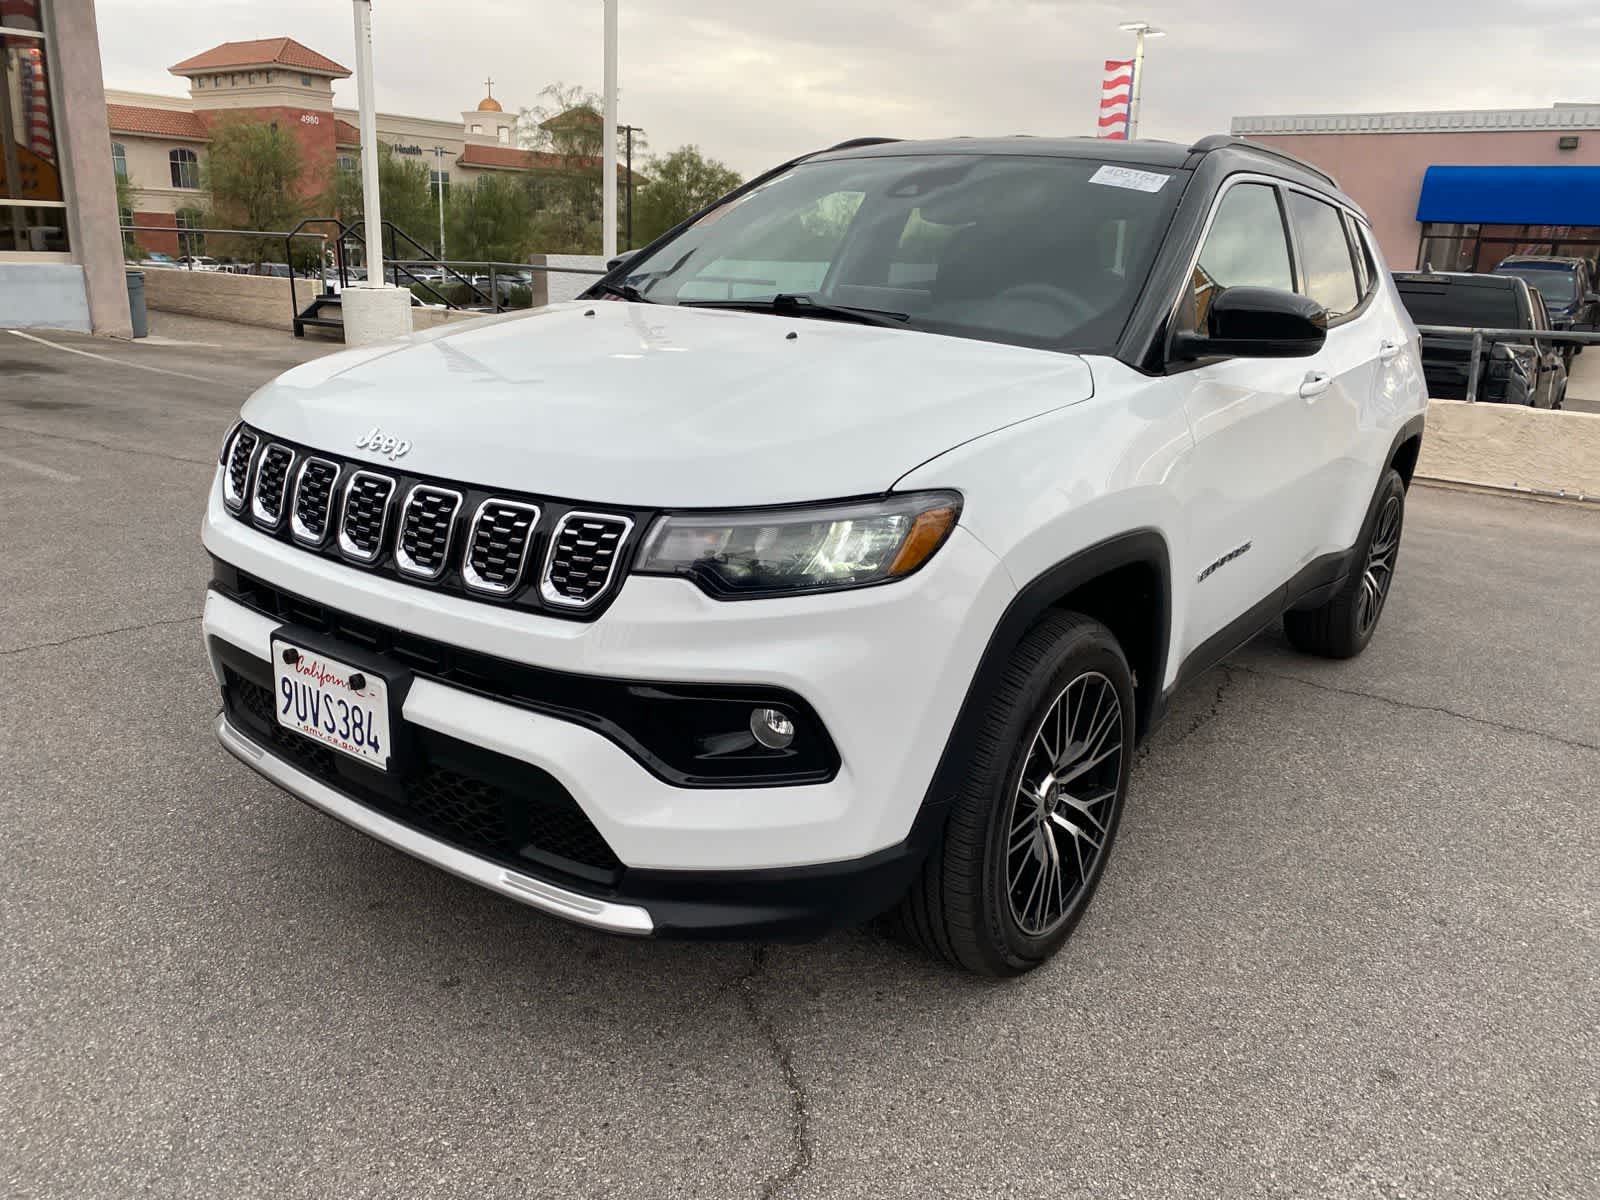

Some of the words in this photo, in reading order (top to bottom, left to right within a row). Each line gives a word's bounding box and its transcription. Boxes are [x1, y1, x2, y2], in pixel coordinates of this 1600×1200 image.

[394, 143, 423, 156] Health
[356, 426, 412, 461] Jeep
[281, 676, 380, 754] 9UVS384
